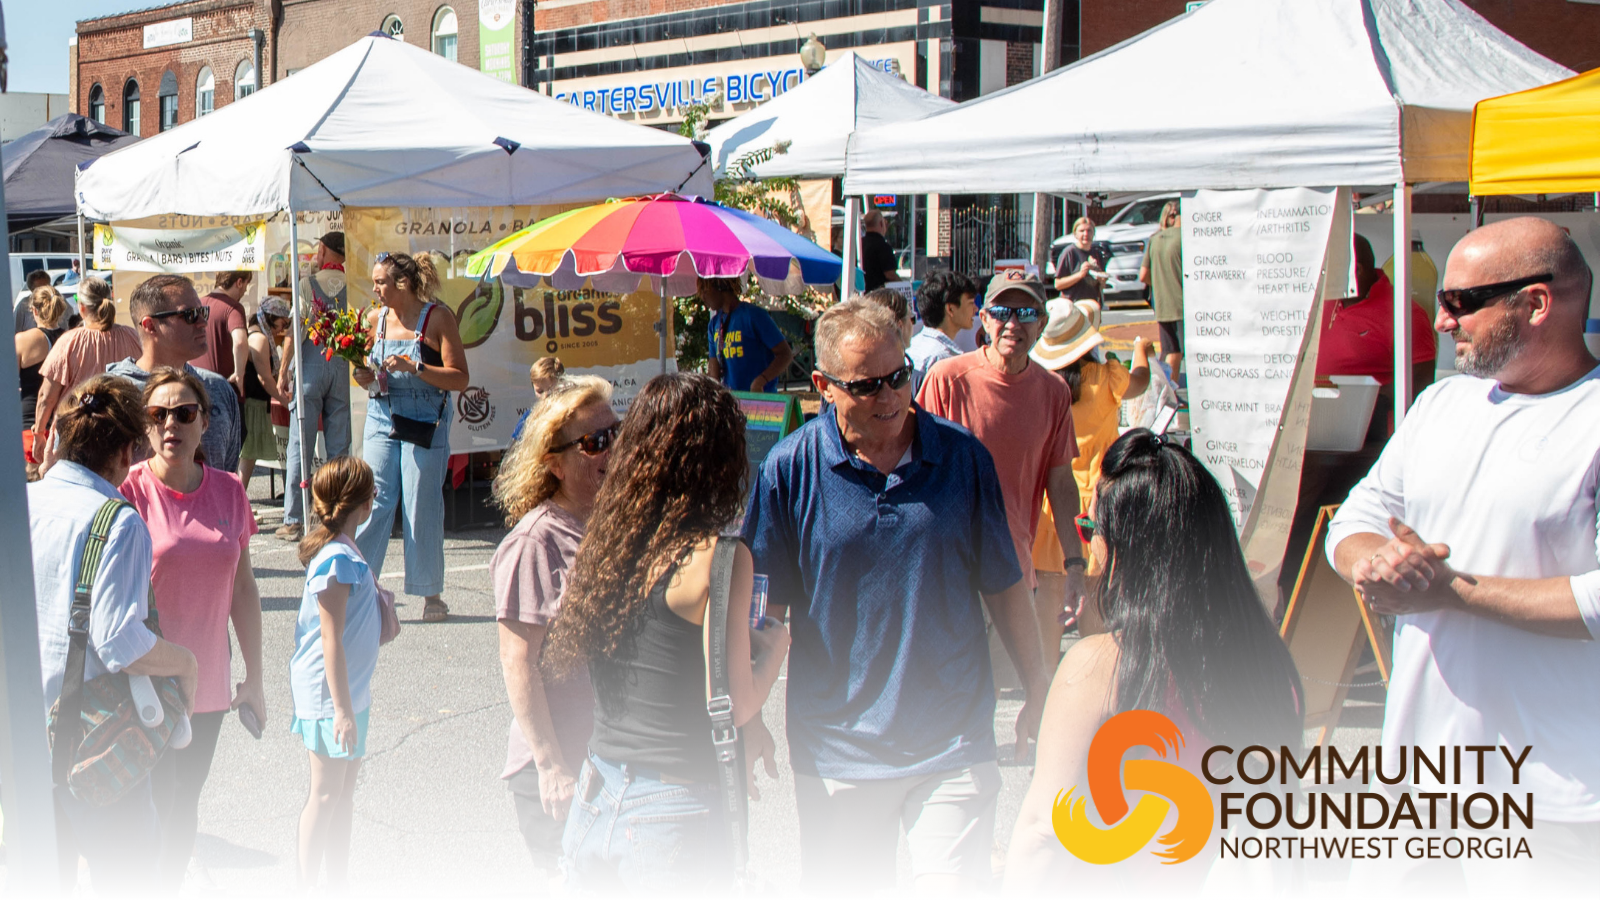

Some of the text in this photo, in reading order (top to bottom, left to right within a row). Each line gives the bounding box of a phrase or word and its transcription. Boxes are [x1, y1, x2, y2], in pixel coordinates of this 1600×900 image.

[556, 77, 716, 113] ARTERSVILLE
[873, 195, 895, 205] OPEN
[1192, 212, 1222, 223] GINGER
[395, 221, 492, 236] GRANOLA
[1192, 226, 1233, 237] PINEAPPLE
[1256, 221, 1311, 236] /ARTHRITIS
[162, 253, 183, 264] BARS
[189, 252, 209, 263] BITES
[215, 251, 232, 262] NUTS
[1193, 255, 1228, 266] GINGER
[1257, 252, 1293, 264] BLOOD
[1193, 270, 1247, 281] STRAWBERRY
[1257, 267, 1311, 279] PRESSURE/
[1257, 282, 1316, 294] HEART HEA
[513, 286, 622, 342] bliss
[1195, 311, 1232, 322] GINGER
[1260, 310, 1309, 321] WEIGHTL
[1196, 326, 1230, 337] LEMON
[560, 340, 598, 350] SINCE 2005
[1196, 353, 1232, 363] GINGER
[1198, 367, 1260, 379] LEMONGRASS
[624, 378, 637, 386] GA
[1201, 399, 1259, 413] GINGER MINT
[1265, 403, 1282, 413] BRA
[468, 421, 491, 431] GLUTEN
[1206, 440, 1238, 453] GINGER
[1207, 455, 1264, 470] WATERMELON
[1223, 488, 1247, 499] NGER
[727, 789, 738, 812] STEVE
